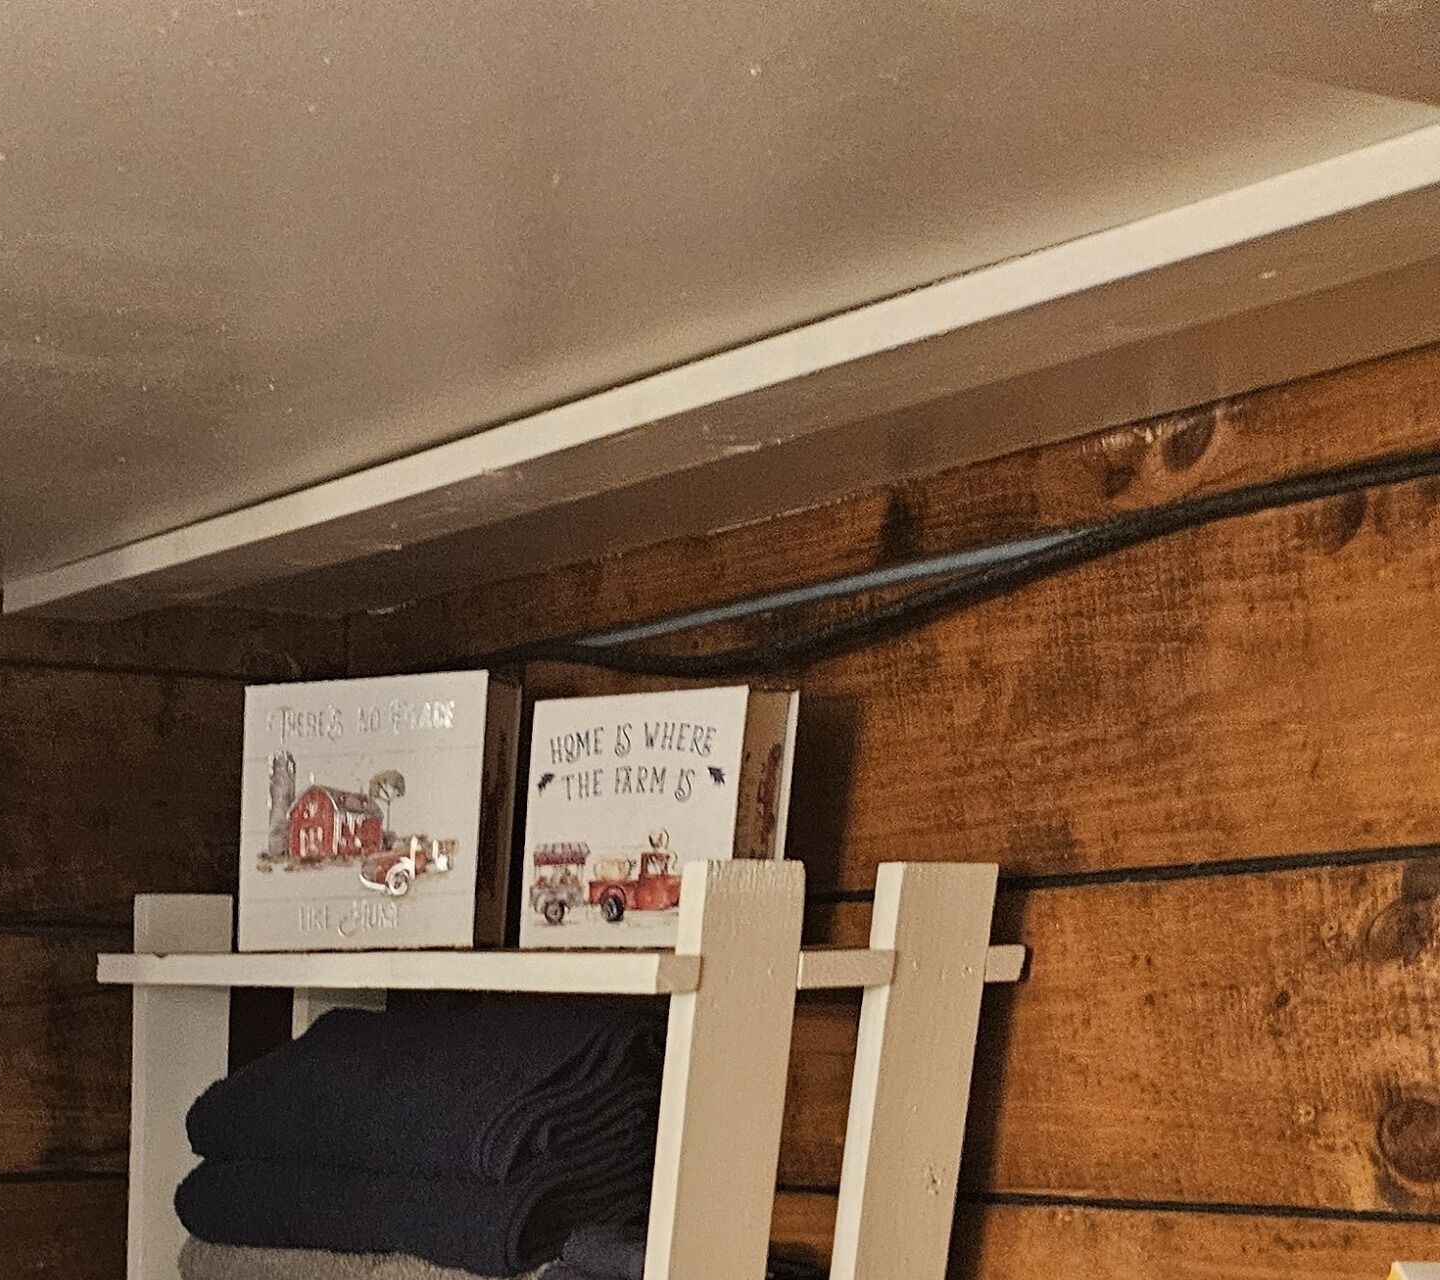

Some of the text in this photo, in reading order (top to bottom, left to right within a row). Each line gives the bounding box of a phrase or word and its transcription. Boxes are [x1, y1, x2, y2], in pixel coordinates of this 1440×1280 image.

[550, 721, 717, 765] HOME IS WHERE
[561, 765, 696, 803] THE FARM IS
